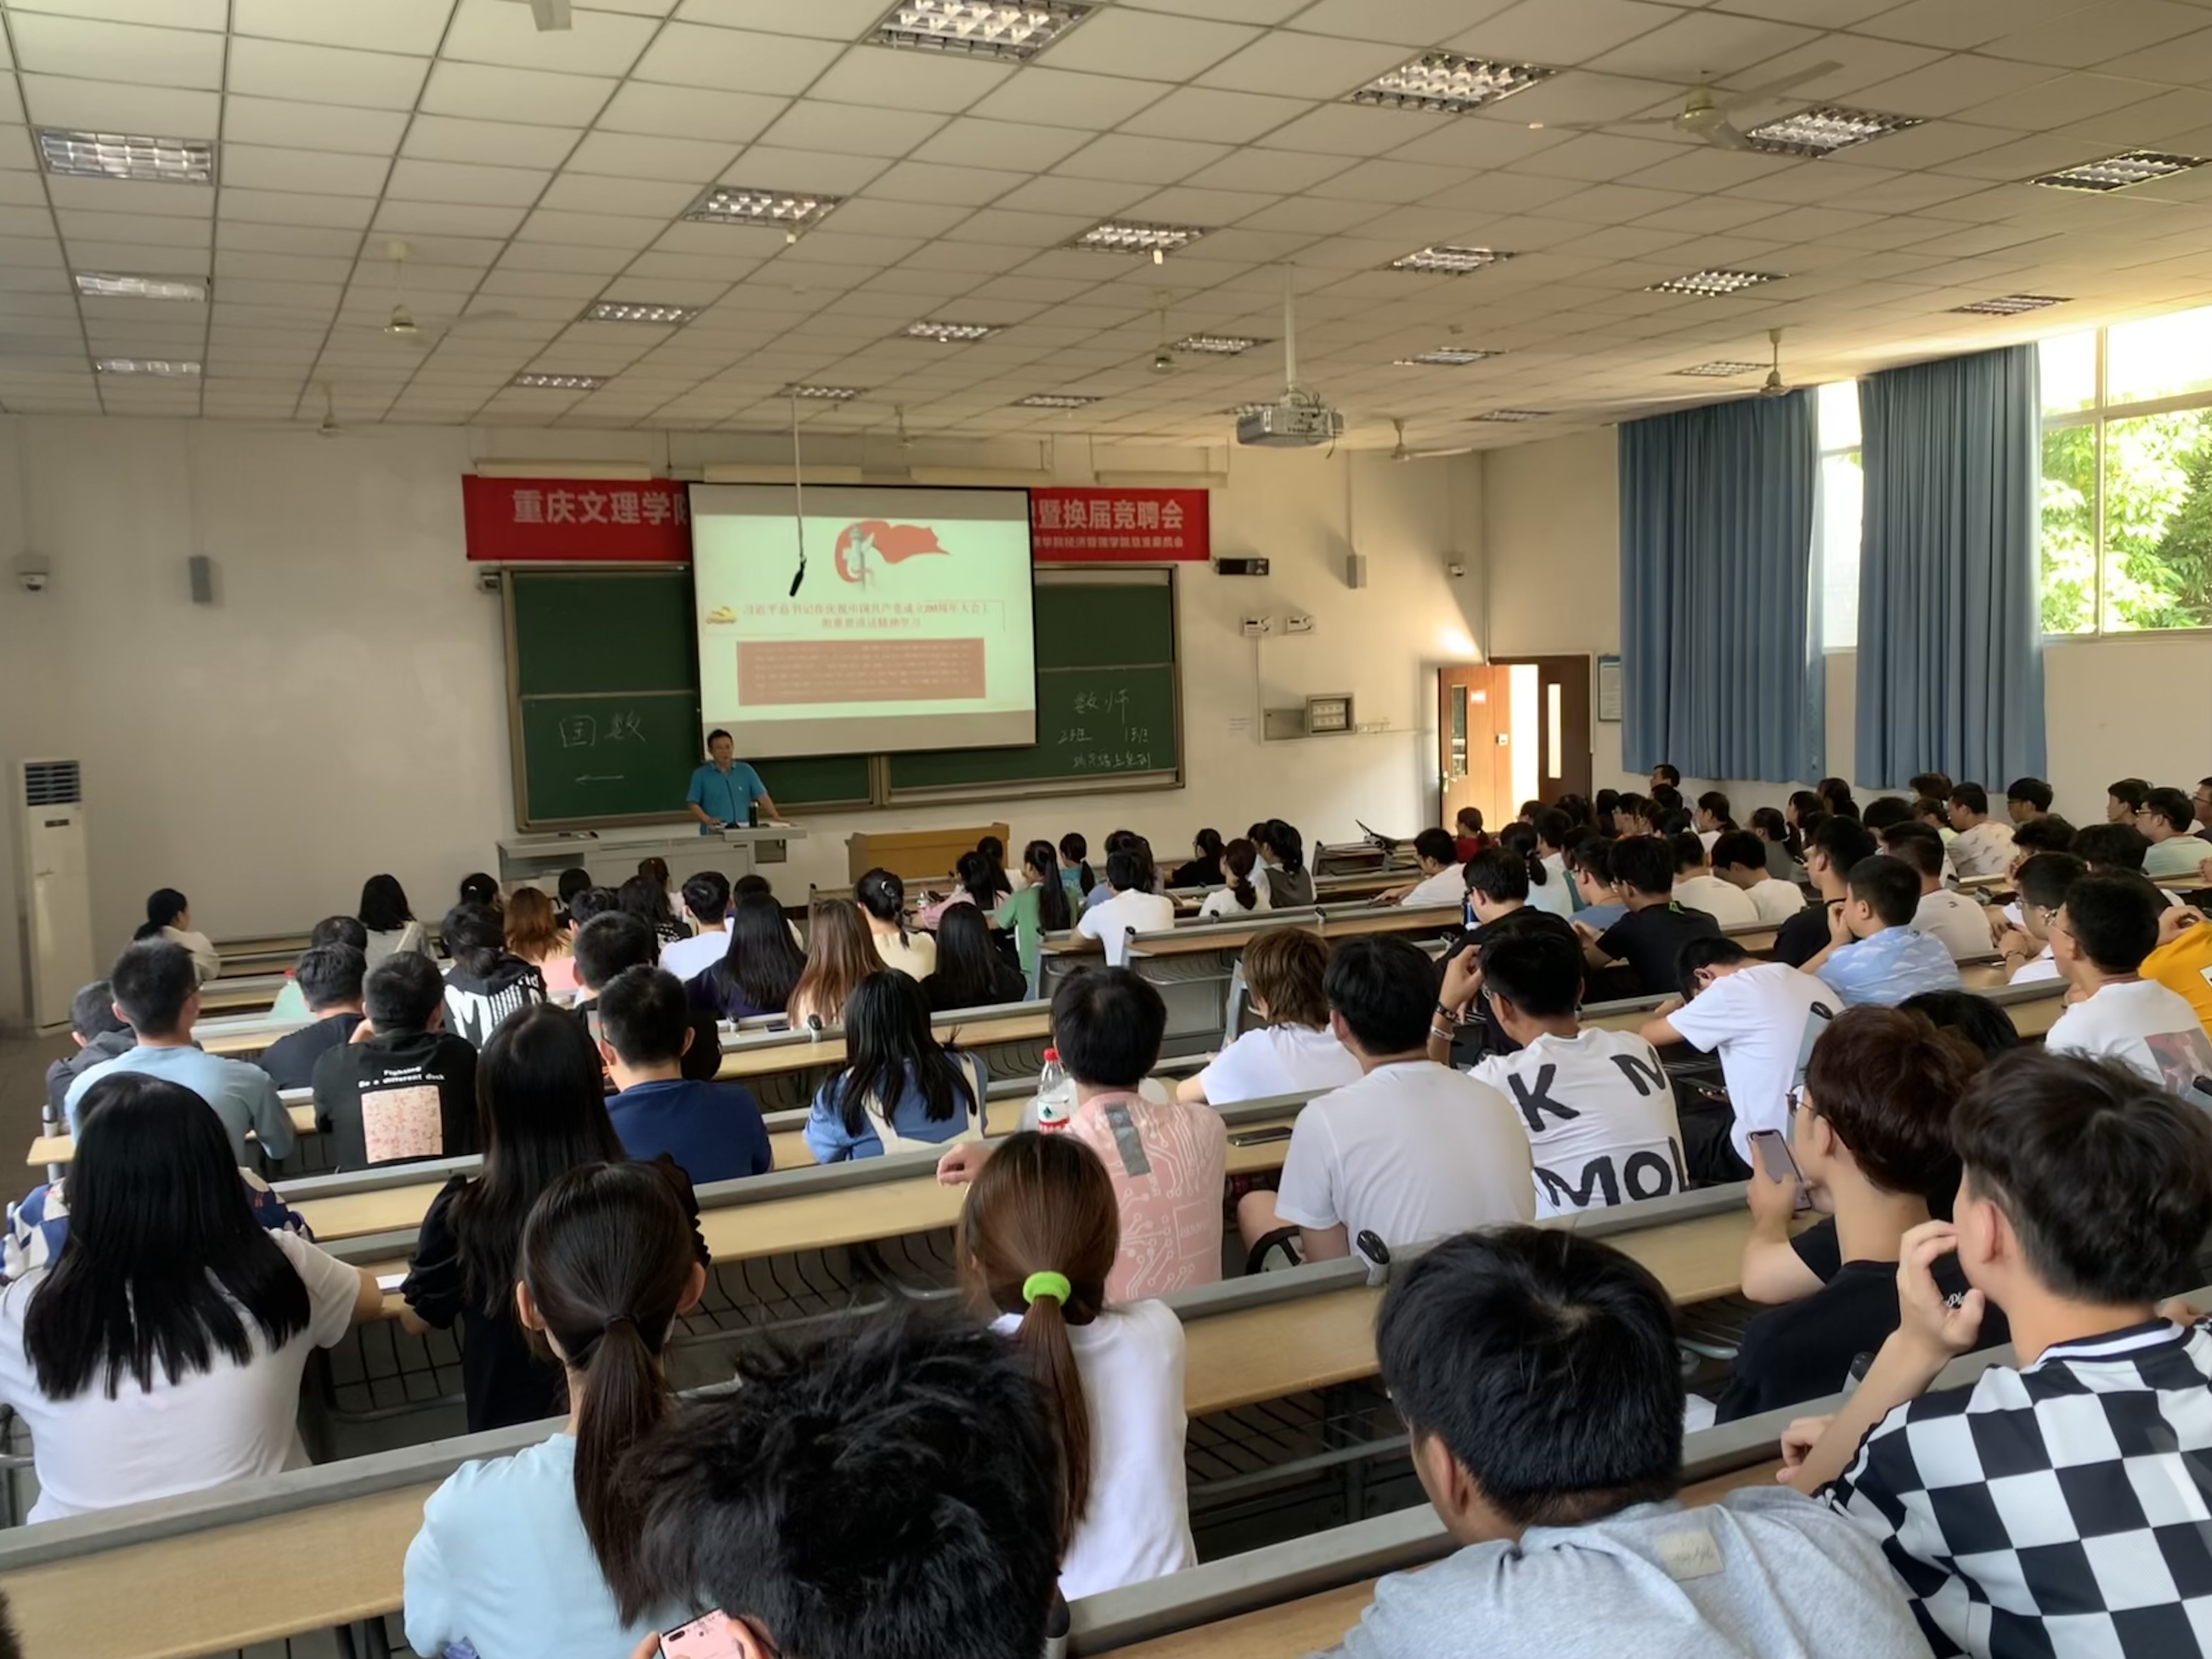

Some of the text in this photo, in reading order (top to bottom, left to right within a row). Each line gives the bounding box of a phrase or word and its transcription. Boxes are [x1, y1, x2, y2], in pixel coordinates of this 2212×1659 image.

[1031, 498, 1183, 529] 暨换届竞聘会
